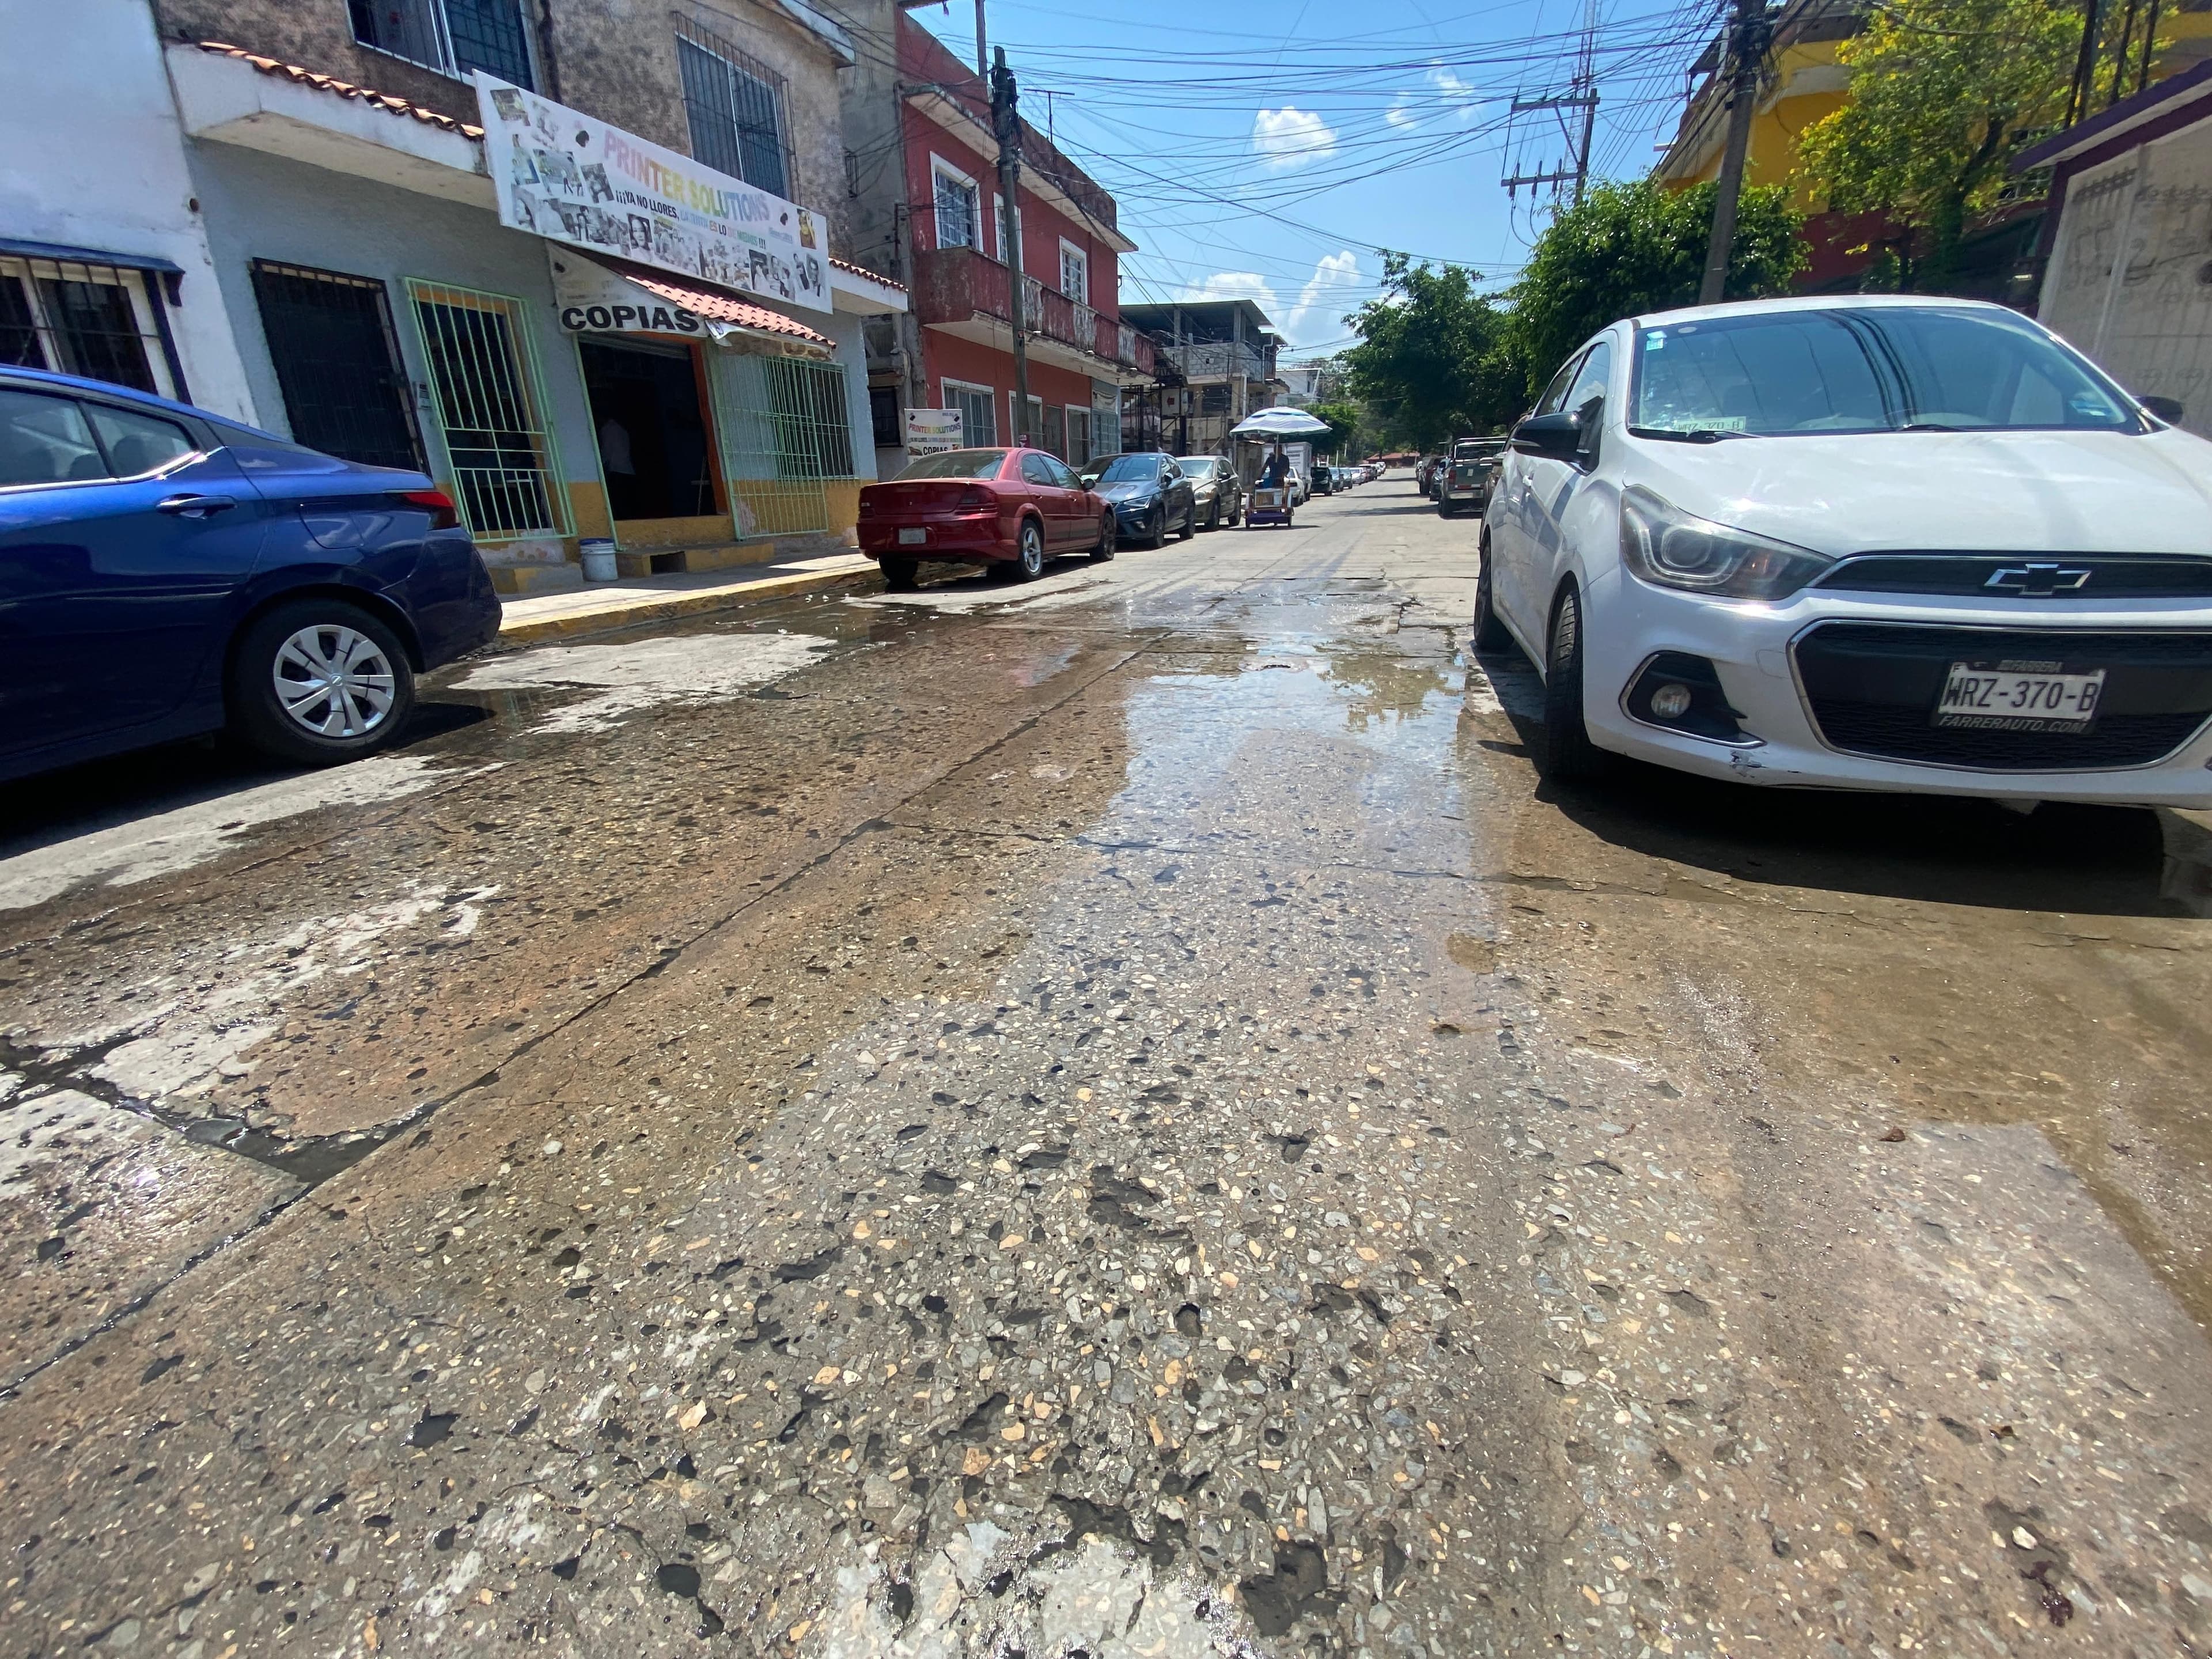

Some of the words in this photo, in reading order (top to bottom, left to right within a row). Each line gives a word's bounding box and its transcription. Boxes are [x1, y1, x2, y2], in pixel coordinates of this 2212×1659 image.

[604, 130, 685, 204] PRINTER
[688, 179, 770, 221] SOLUTIONS
[637, 195, 647, 209] NO
[649, 199, 679, 221] LLORES,
[719, 223, 727, 236] LO
[562, 306, 699, 332] COPIAS
[908, 423, 931, 434] PRINTER
[933, 423, 961, 434] SOLUTIONS
[1941, 677, 2099, 712] WRZ-370-B
